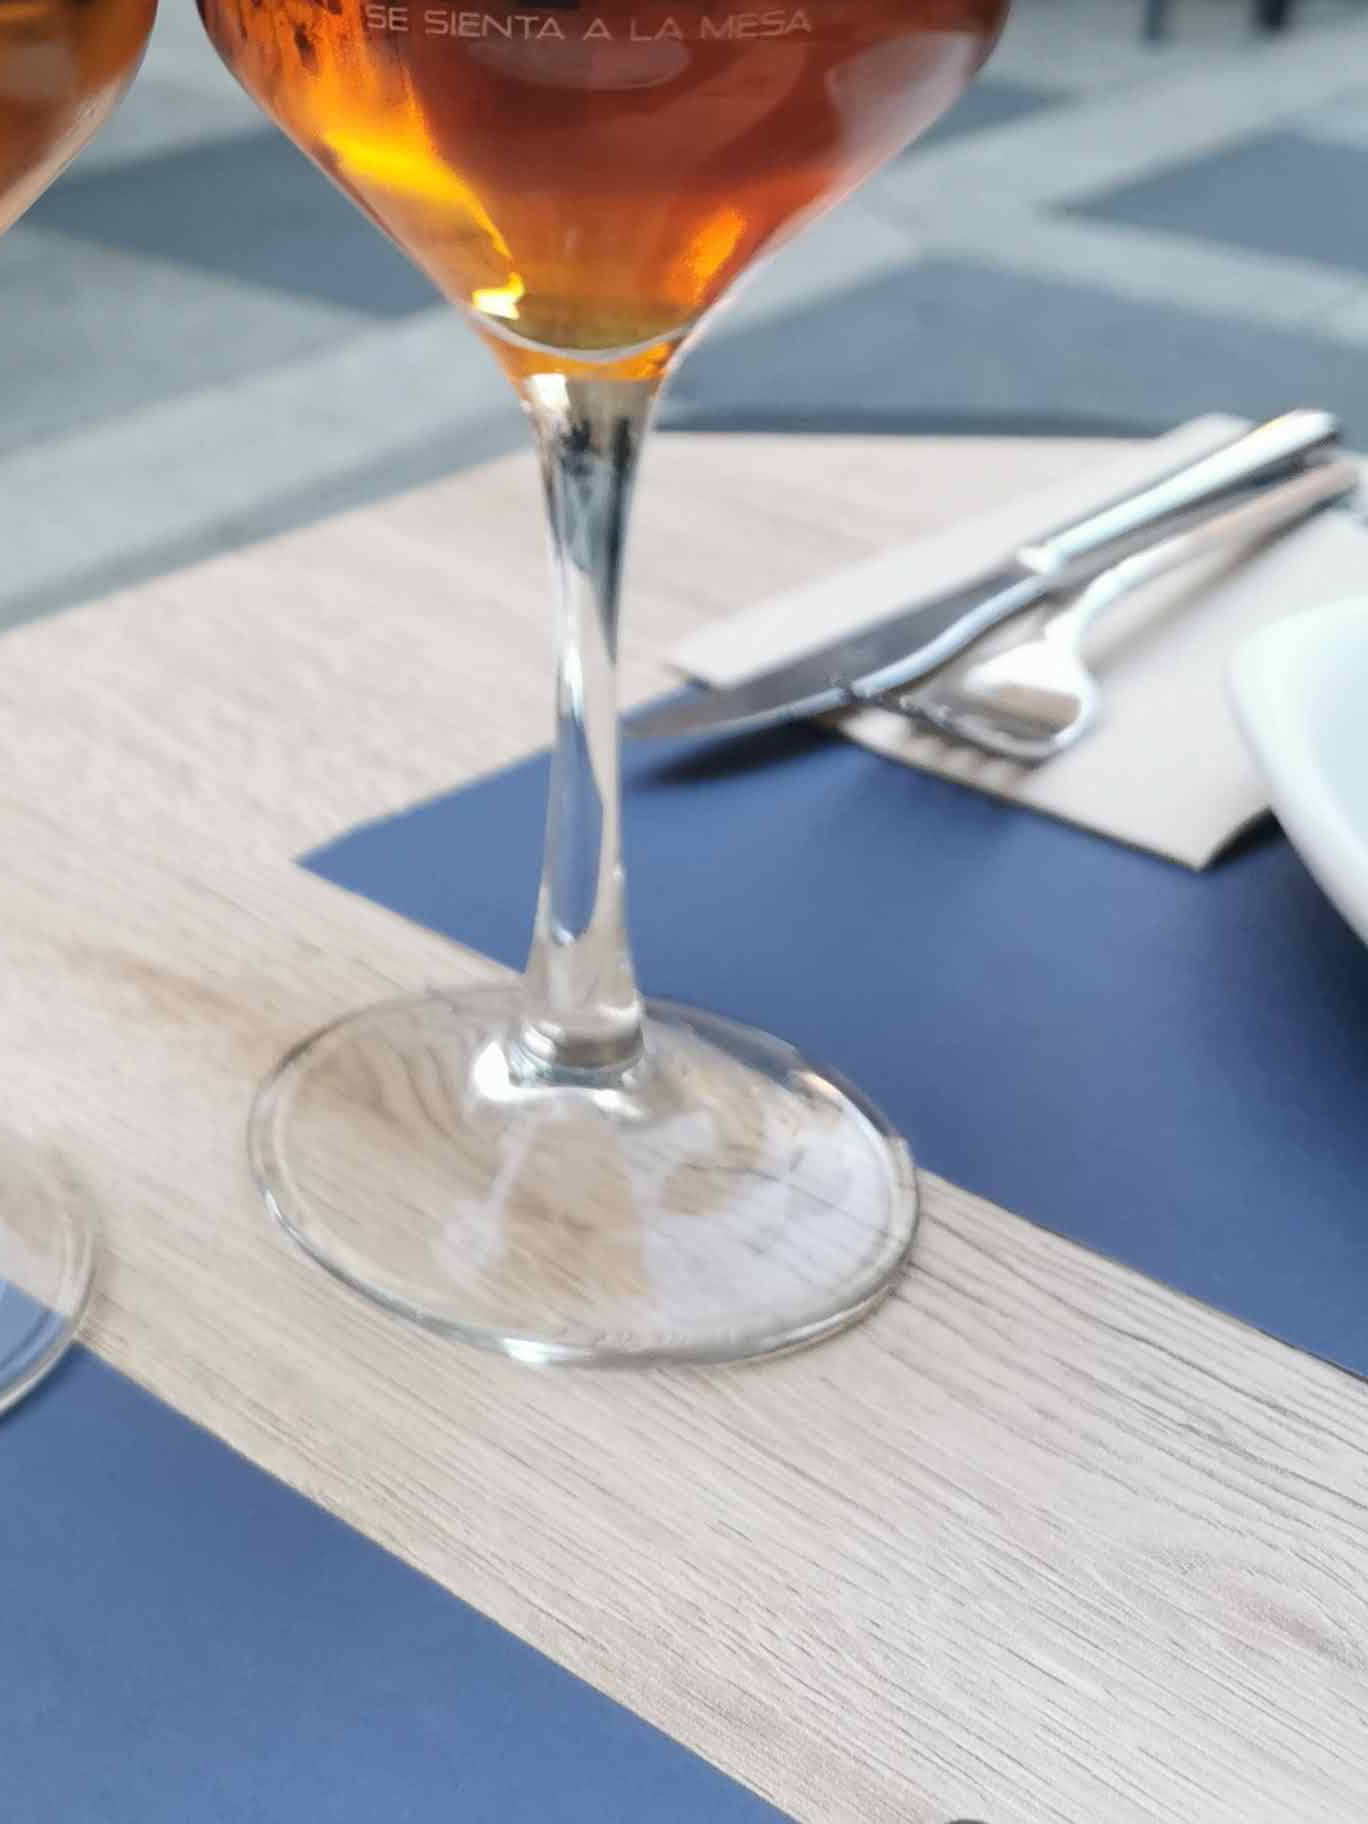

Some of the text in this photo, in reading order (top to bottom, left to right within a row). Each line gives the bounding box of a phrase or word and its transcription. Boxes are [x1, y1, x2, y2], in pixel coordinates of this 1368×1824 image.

[365, 4, 813, 42] SE SIENTA A LA MESA
